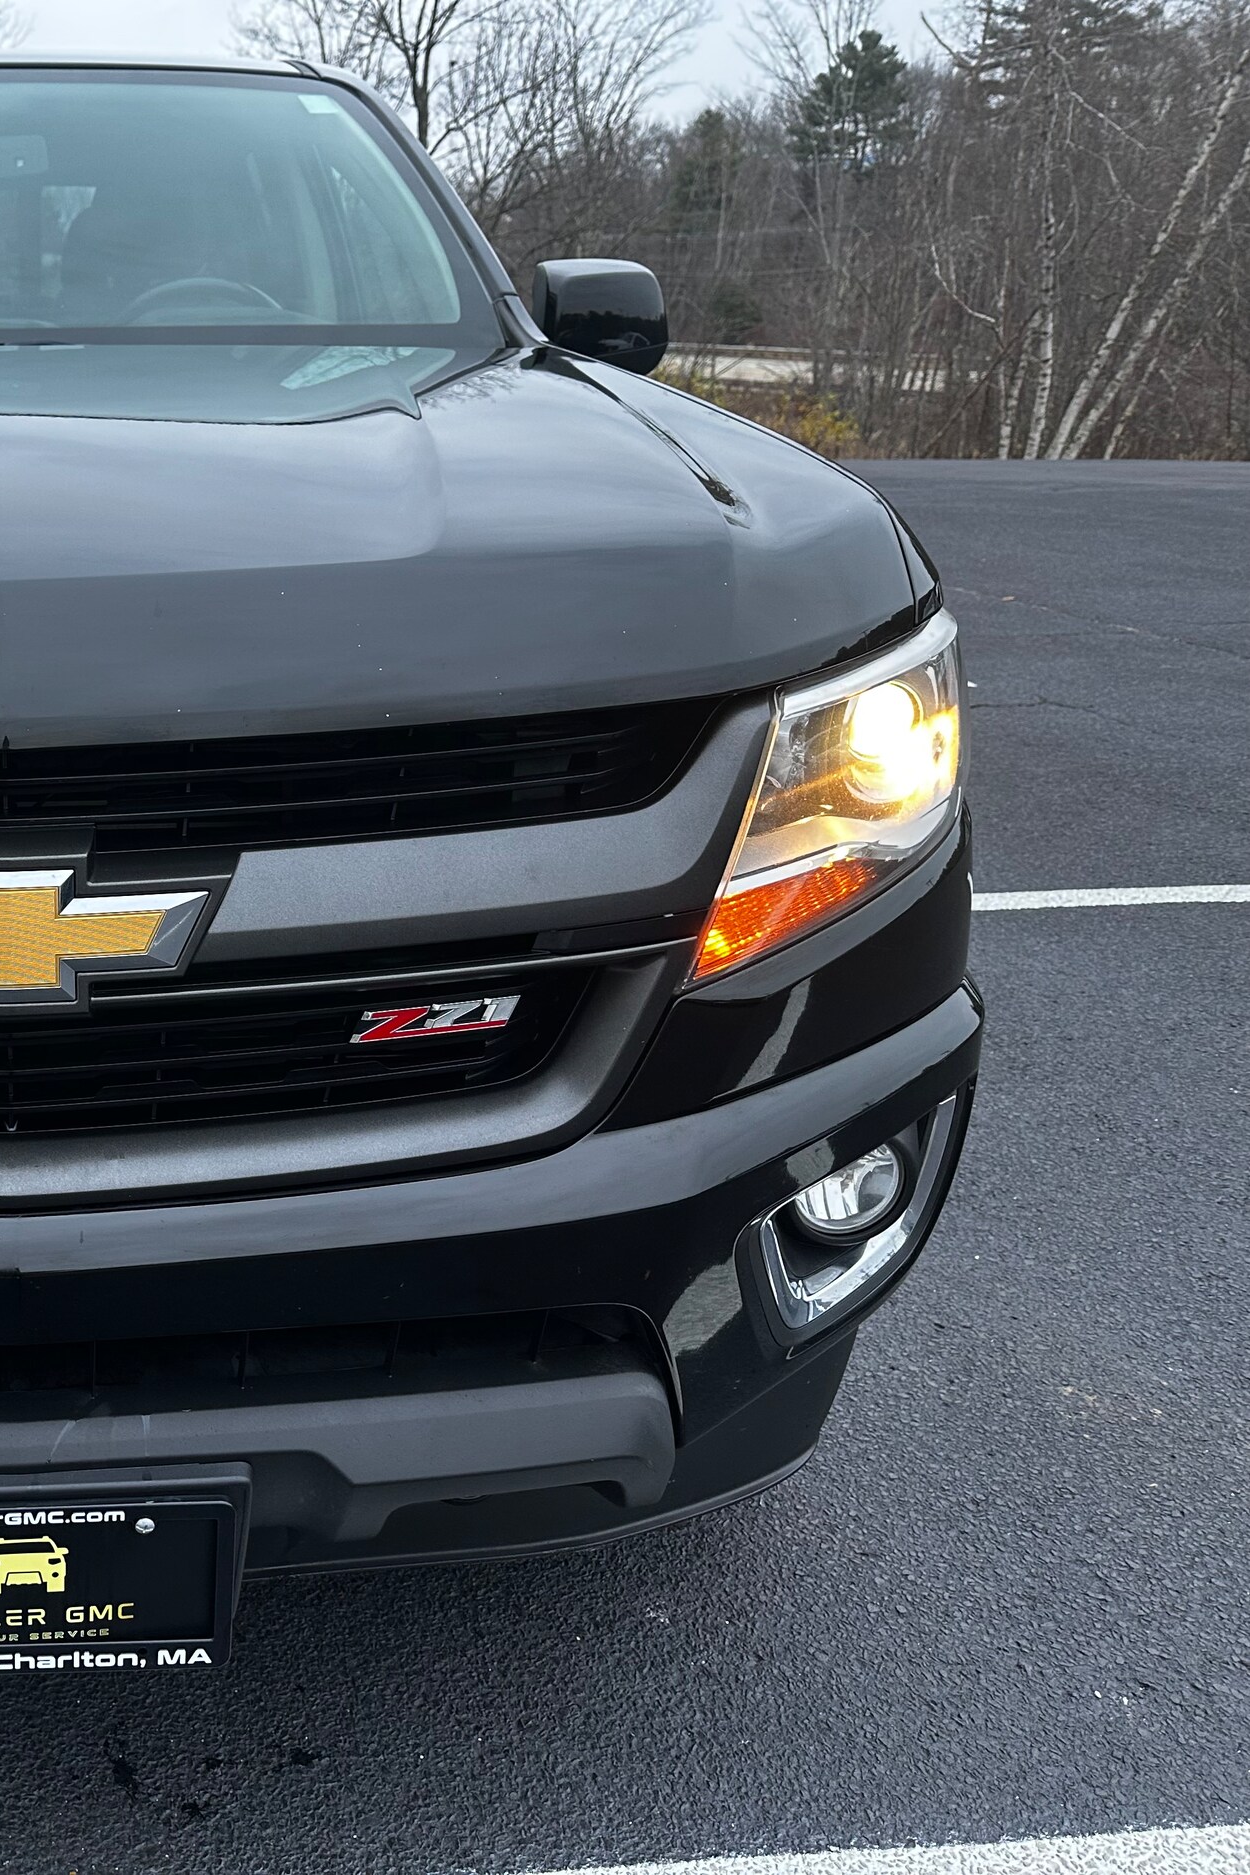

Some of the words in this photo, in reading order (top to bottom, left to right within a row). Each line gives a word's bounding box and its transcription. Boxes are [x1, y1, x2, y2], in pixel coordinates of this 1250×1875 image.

[349, 994, 521, 1043] Z71
[65, 1602, 134, 1623] GMC
[29, 1628, 110, 1641] SERVICE
[156, 1648, 212, 1666] MA
